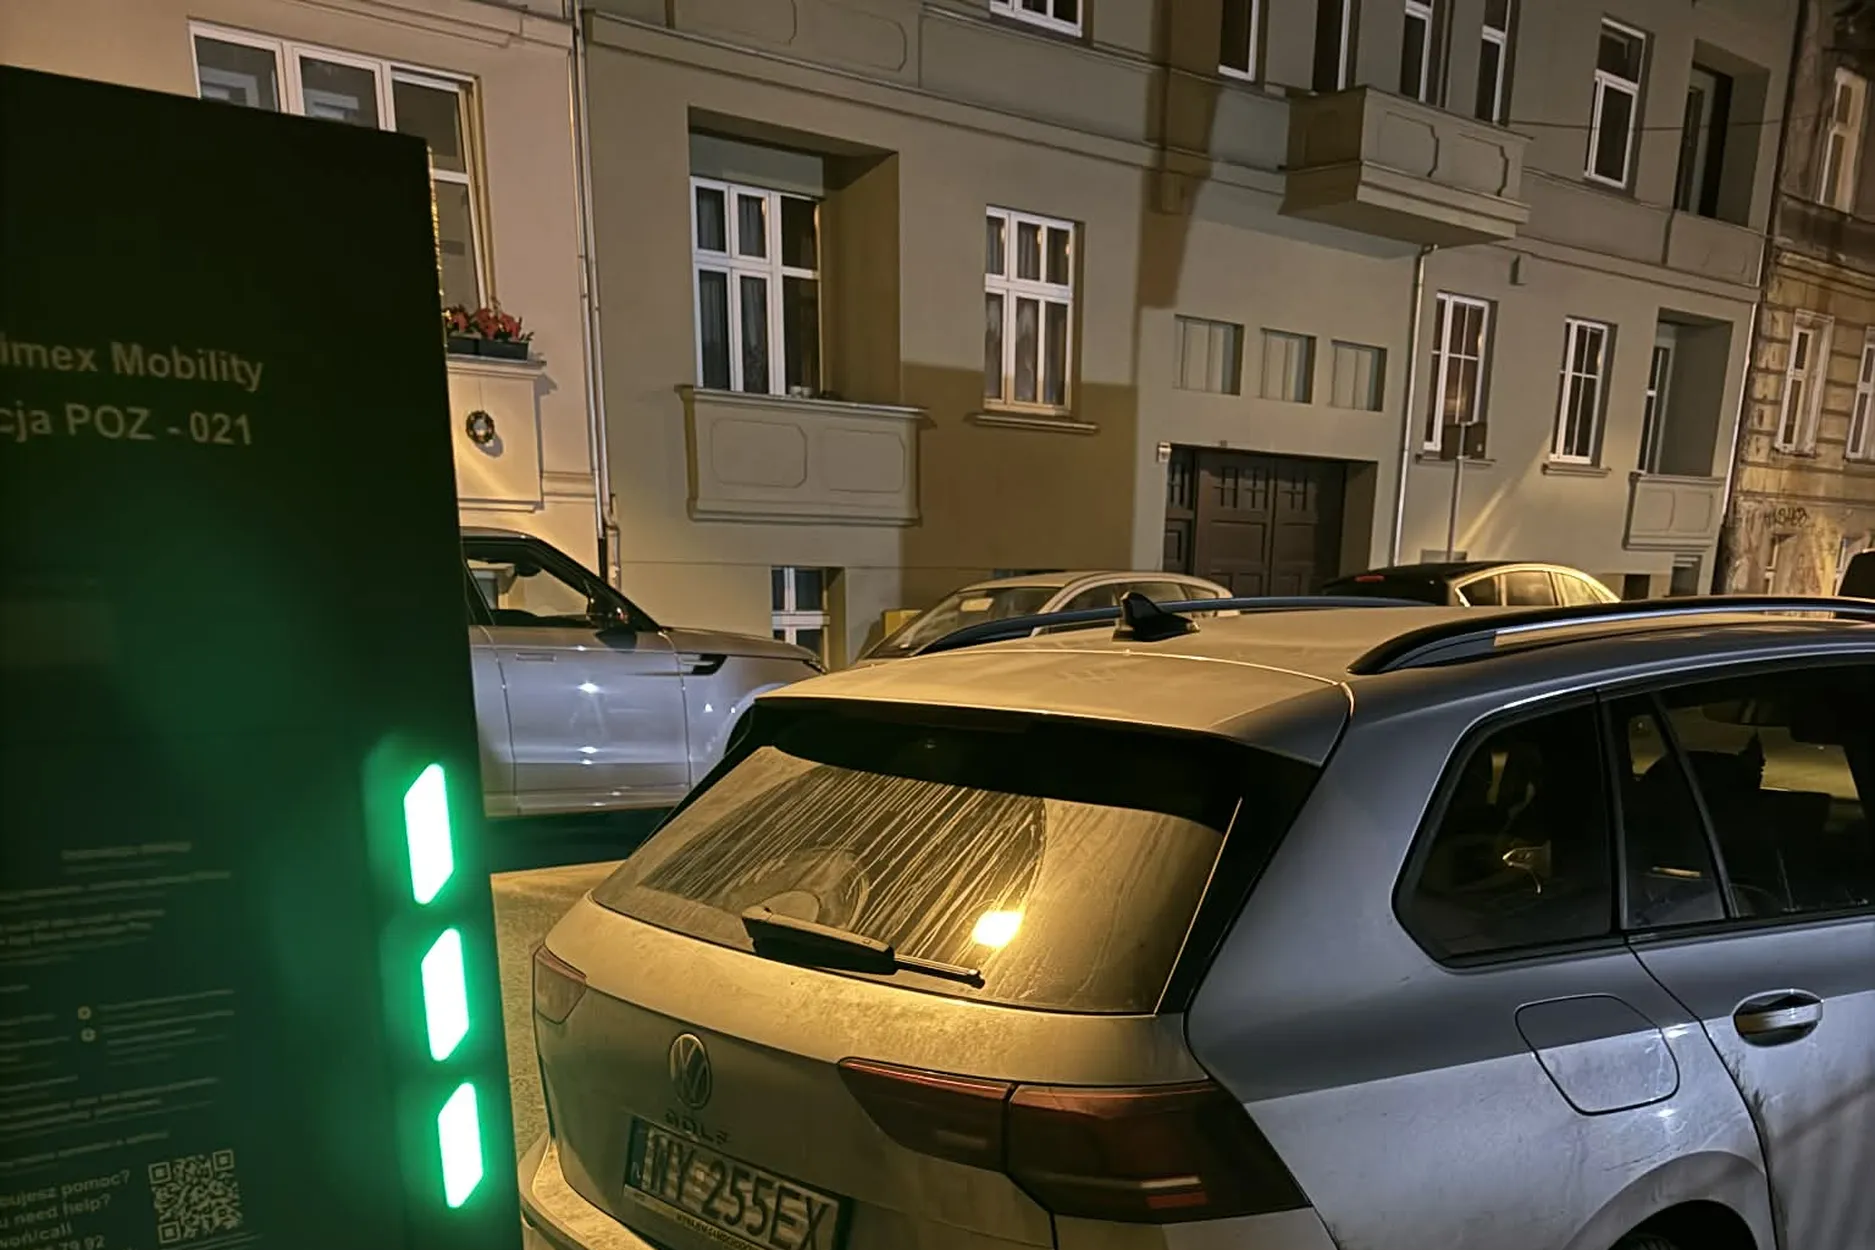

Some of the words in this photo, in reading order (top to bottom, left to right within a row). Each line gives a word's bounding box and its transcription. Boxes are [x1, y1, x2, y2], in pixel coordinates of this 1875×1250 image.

[110, 342, 265, 393] Mobility
[65, 402, 156, 440] POZ
[189, 410, 254, 447] 021
[61, 1169, 130, 1200] pomoc?
[14, 1206, 58, 1226] need
[62, 1193, 111, 1219] help?
[84, 1234, 105, 1250] 92
